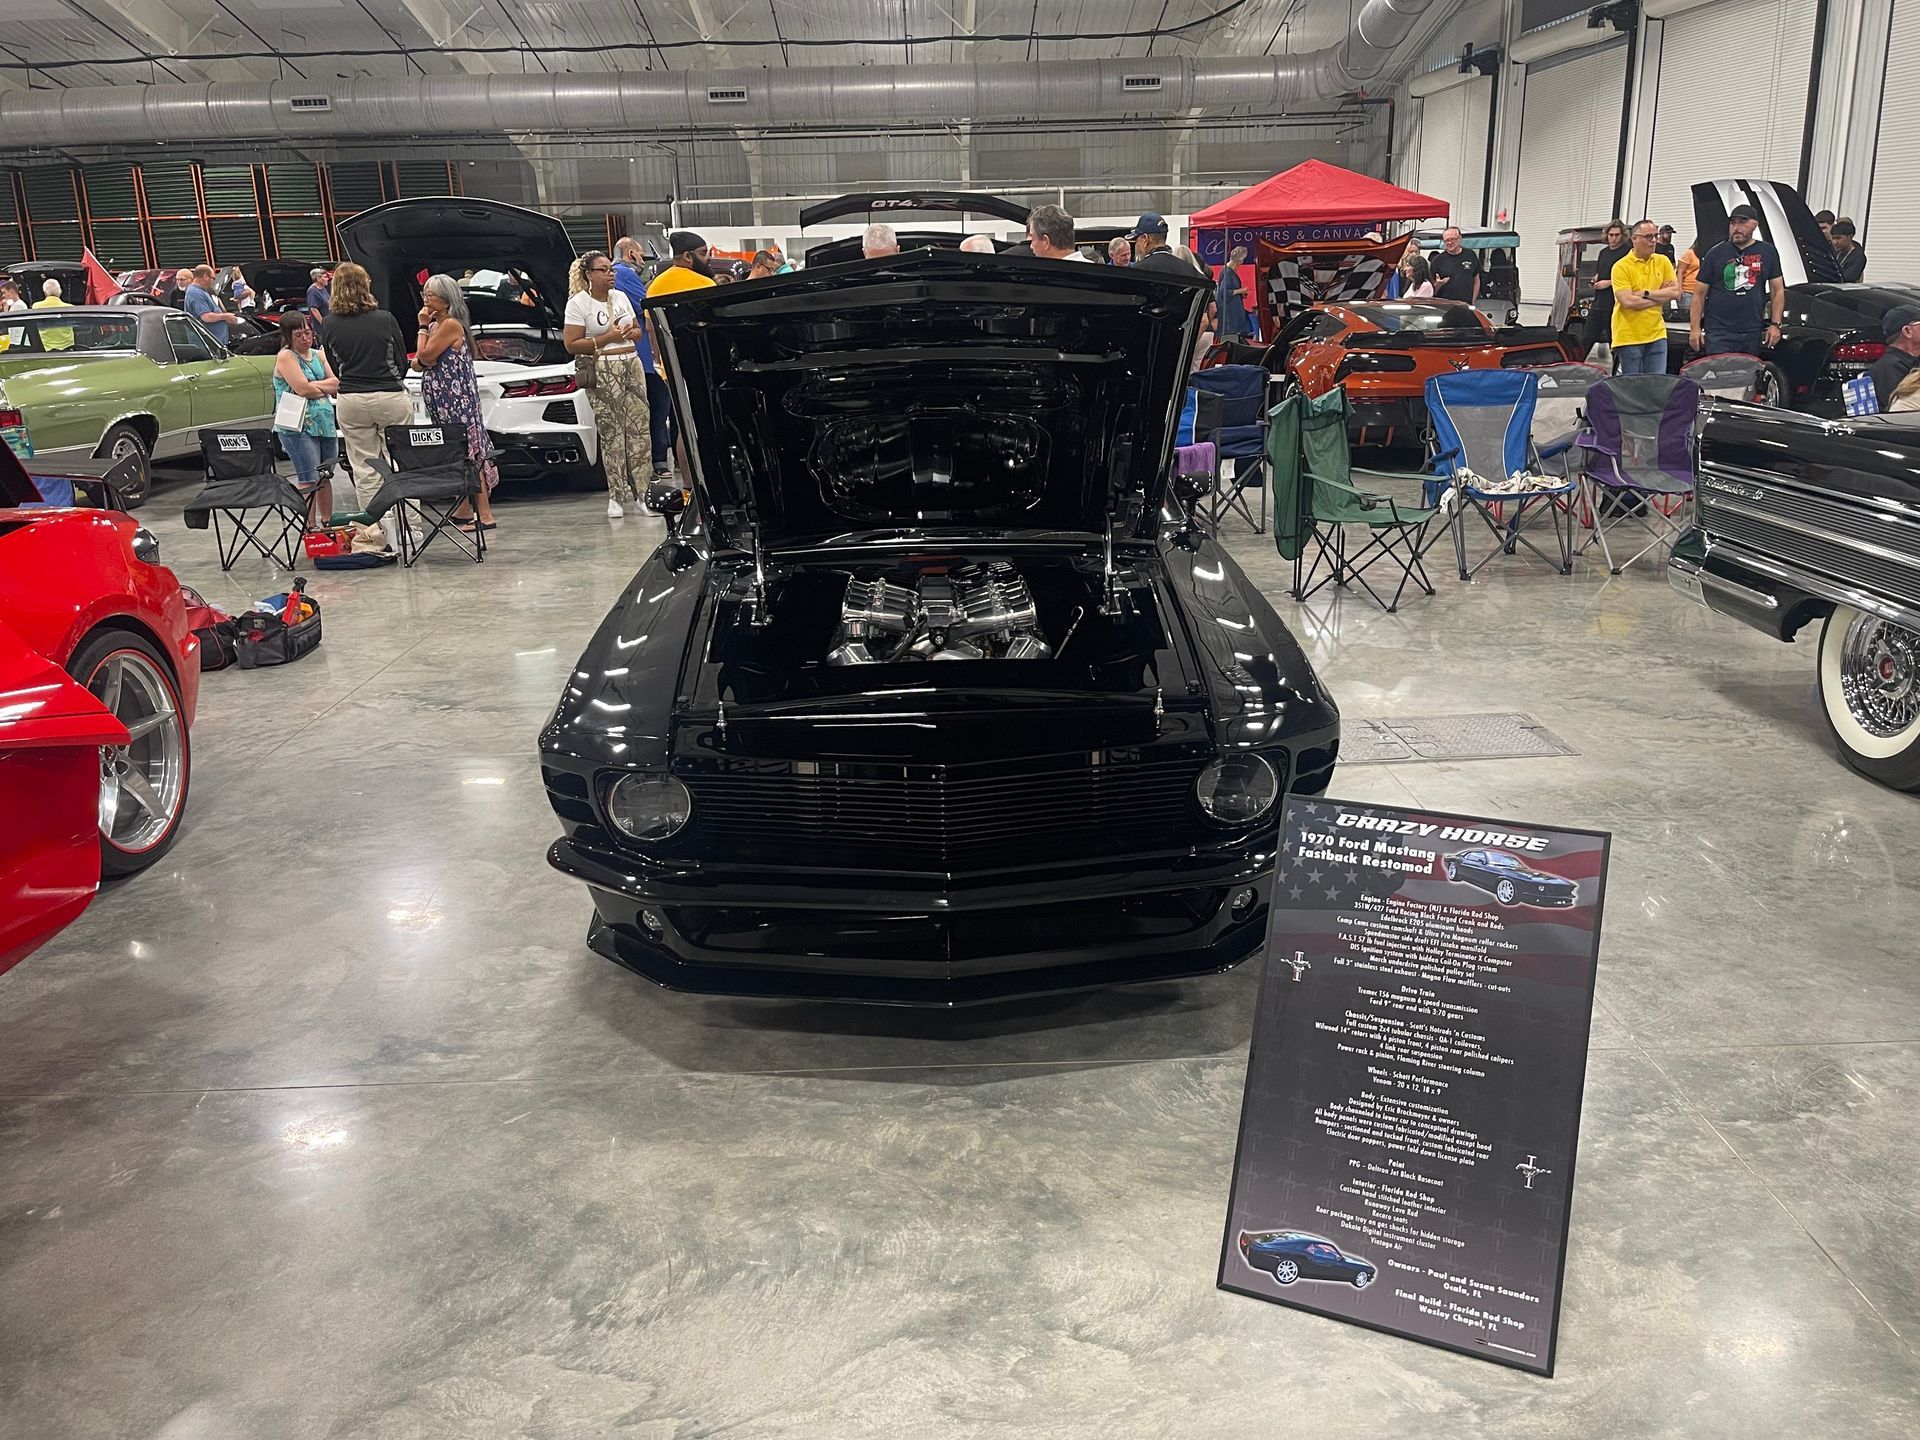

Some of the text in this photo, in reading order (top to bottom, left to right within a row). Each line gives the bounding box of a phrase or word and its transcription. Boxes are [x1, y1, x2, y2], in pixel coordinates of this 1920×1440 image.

[1296, 231, 1305, 239] &
[219, 437, 249, 447] DICK'S
[412, 432, 441, 442] DICK'S
[1334, 812, 1549, 851] CRAZY HORSE
[1300, 831, 1435, 861] 1970 Ford Mustang
[1298, 845, 1432, 874] Fastback Restomod
[1360, 894, 1381, 904] Engine
[1385, 898, 1405, 907] Engine
[1406, 901, 1427, 910] Factory
[1449, 907, 1469, 916] Florida
[1483, 912, 1499, 921] Shop
[1399, 908, 1418, 918] Racing
[1420, 911, 1435, 919] Block
[1437, 914, 1457, 924] Forged
[1458, 917, 1475, 925] Crank
[1490, 921, 1504, 930] Rods
[1380, 913, 1407, 923] Edelbrock
[1425, 920, 1454, 931] aluminum
[1456, 925, 1473, 933] heads
[1364, 928, 1399, 940] Speedmaster
[1414, 935, 1428, 944] draft
[1440, 940, 1458, 948] intake
[1460, 943, 1486, 953] manifold
[1369, 954, 1387, 963] March
[1420, 962, 1444, 973] polished
[1446, 966, 1464, 977] pulley
[1357, 986, 1377, 996] Tremec
[1390, 994, 1415, 1003] magnum
[1423, 998, 1439, 1008] speed
[1441, 1001, 1478, 1013] transmission
[1401, 985, 1435, 997] Drive Train
[1369, 997, 1382, 1005] Ford
[1418, 1005, 1431, 1014] with
[1446, 1012, 1463, 1021] gears
[1337, 1043, 1354, 1052] Power
[1355, 1046, 1367, 1054] rack
[1375, 1051, 1395, 1061] pinion,
[1397, 1054, 1420, 1066] Flaming
[1422, 1059, 1436, 1067] River
[1438, 1063, 1461, 1074] steering
[1463, 1067, 1484, 1077] column
[1411, 1049, 1442, 1060] suspension
[1367, 1066, 1387, 1076] Wheels
[1411, 1074, 1448, 1087] Performance
[1348, 1097, 1374, 1109] Designed
[1384, 1104, 1394, 1112] Eric
[1438, 1117, 1459, 1126] owners
[1361, 1090, 1448, 1114] Body Extensive customization
[1323, 1109, 1337, 1119] body
[1338, 1113, 1357, 1123] panels
[1373, 1121, 1393, 1130] custom
[1455, 1138, 1475, 1148] except
[1476, 1141, 1491, 1151] hood
[1329, 1102, 1344, 1112] Body
[1345, 1105, 1373, 1117] channeled
[1382, 1113, 1398, 1122] lower
[1417, 1120, 1449, 1133] conceptual
[1450, 1127, 1477, 1140] drawings
[1388, 1159, 1404, 1168] Paint
[1400, 1170, 1416, 1180] Black
[1417, 1174, 1443, 1186] Basecoat
[1340, 1184, 1445, 1214] Custom hand stitched leather interior
[1352, 1178, 1376, 1189] Interior
[1381, 1184, 1403, 1195] Florida
[1418, 1192, 1434, 1204] Shop
[1392, 1205, 1405, 1214] Love
[1393, 1216, 1408, 1224] seats
[1316, 1205, 1329, 1214] Rear
[1330, 1208, 1353, 1221] package
[1355, 1216, 1366, 1224] tray
[1389, 1222, 1408, 1233] shocks
[1420, 1230, 1440, 1240] hidden
[1442, 1237, 1464, 1248] storage
[1340, 1220, 1436, 1249] Dakota Digital instrument cluster
[1370, 1237, 1392, 1249] Vintage
[1387, 1259, 1539, 1302] Owners Paul and Susan Saunders
[1443, 1282, 1481, 1298] Ocala, FL
[1395, 1288, 1524, 1330] Final Build Florida Rod Shop
[1418, 1304, 1497, 1331] Wesley Chapel, FL
